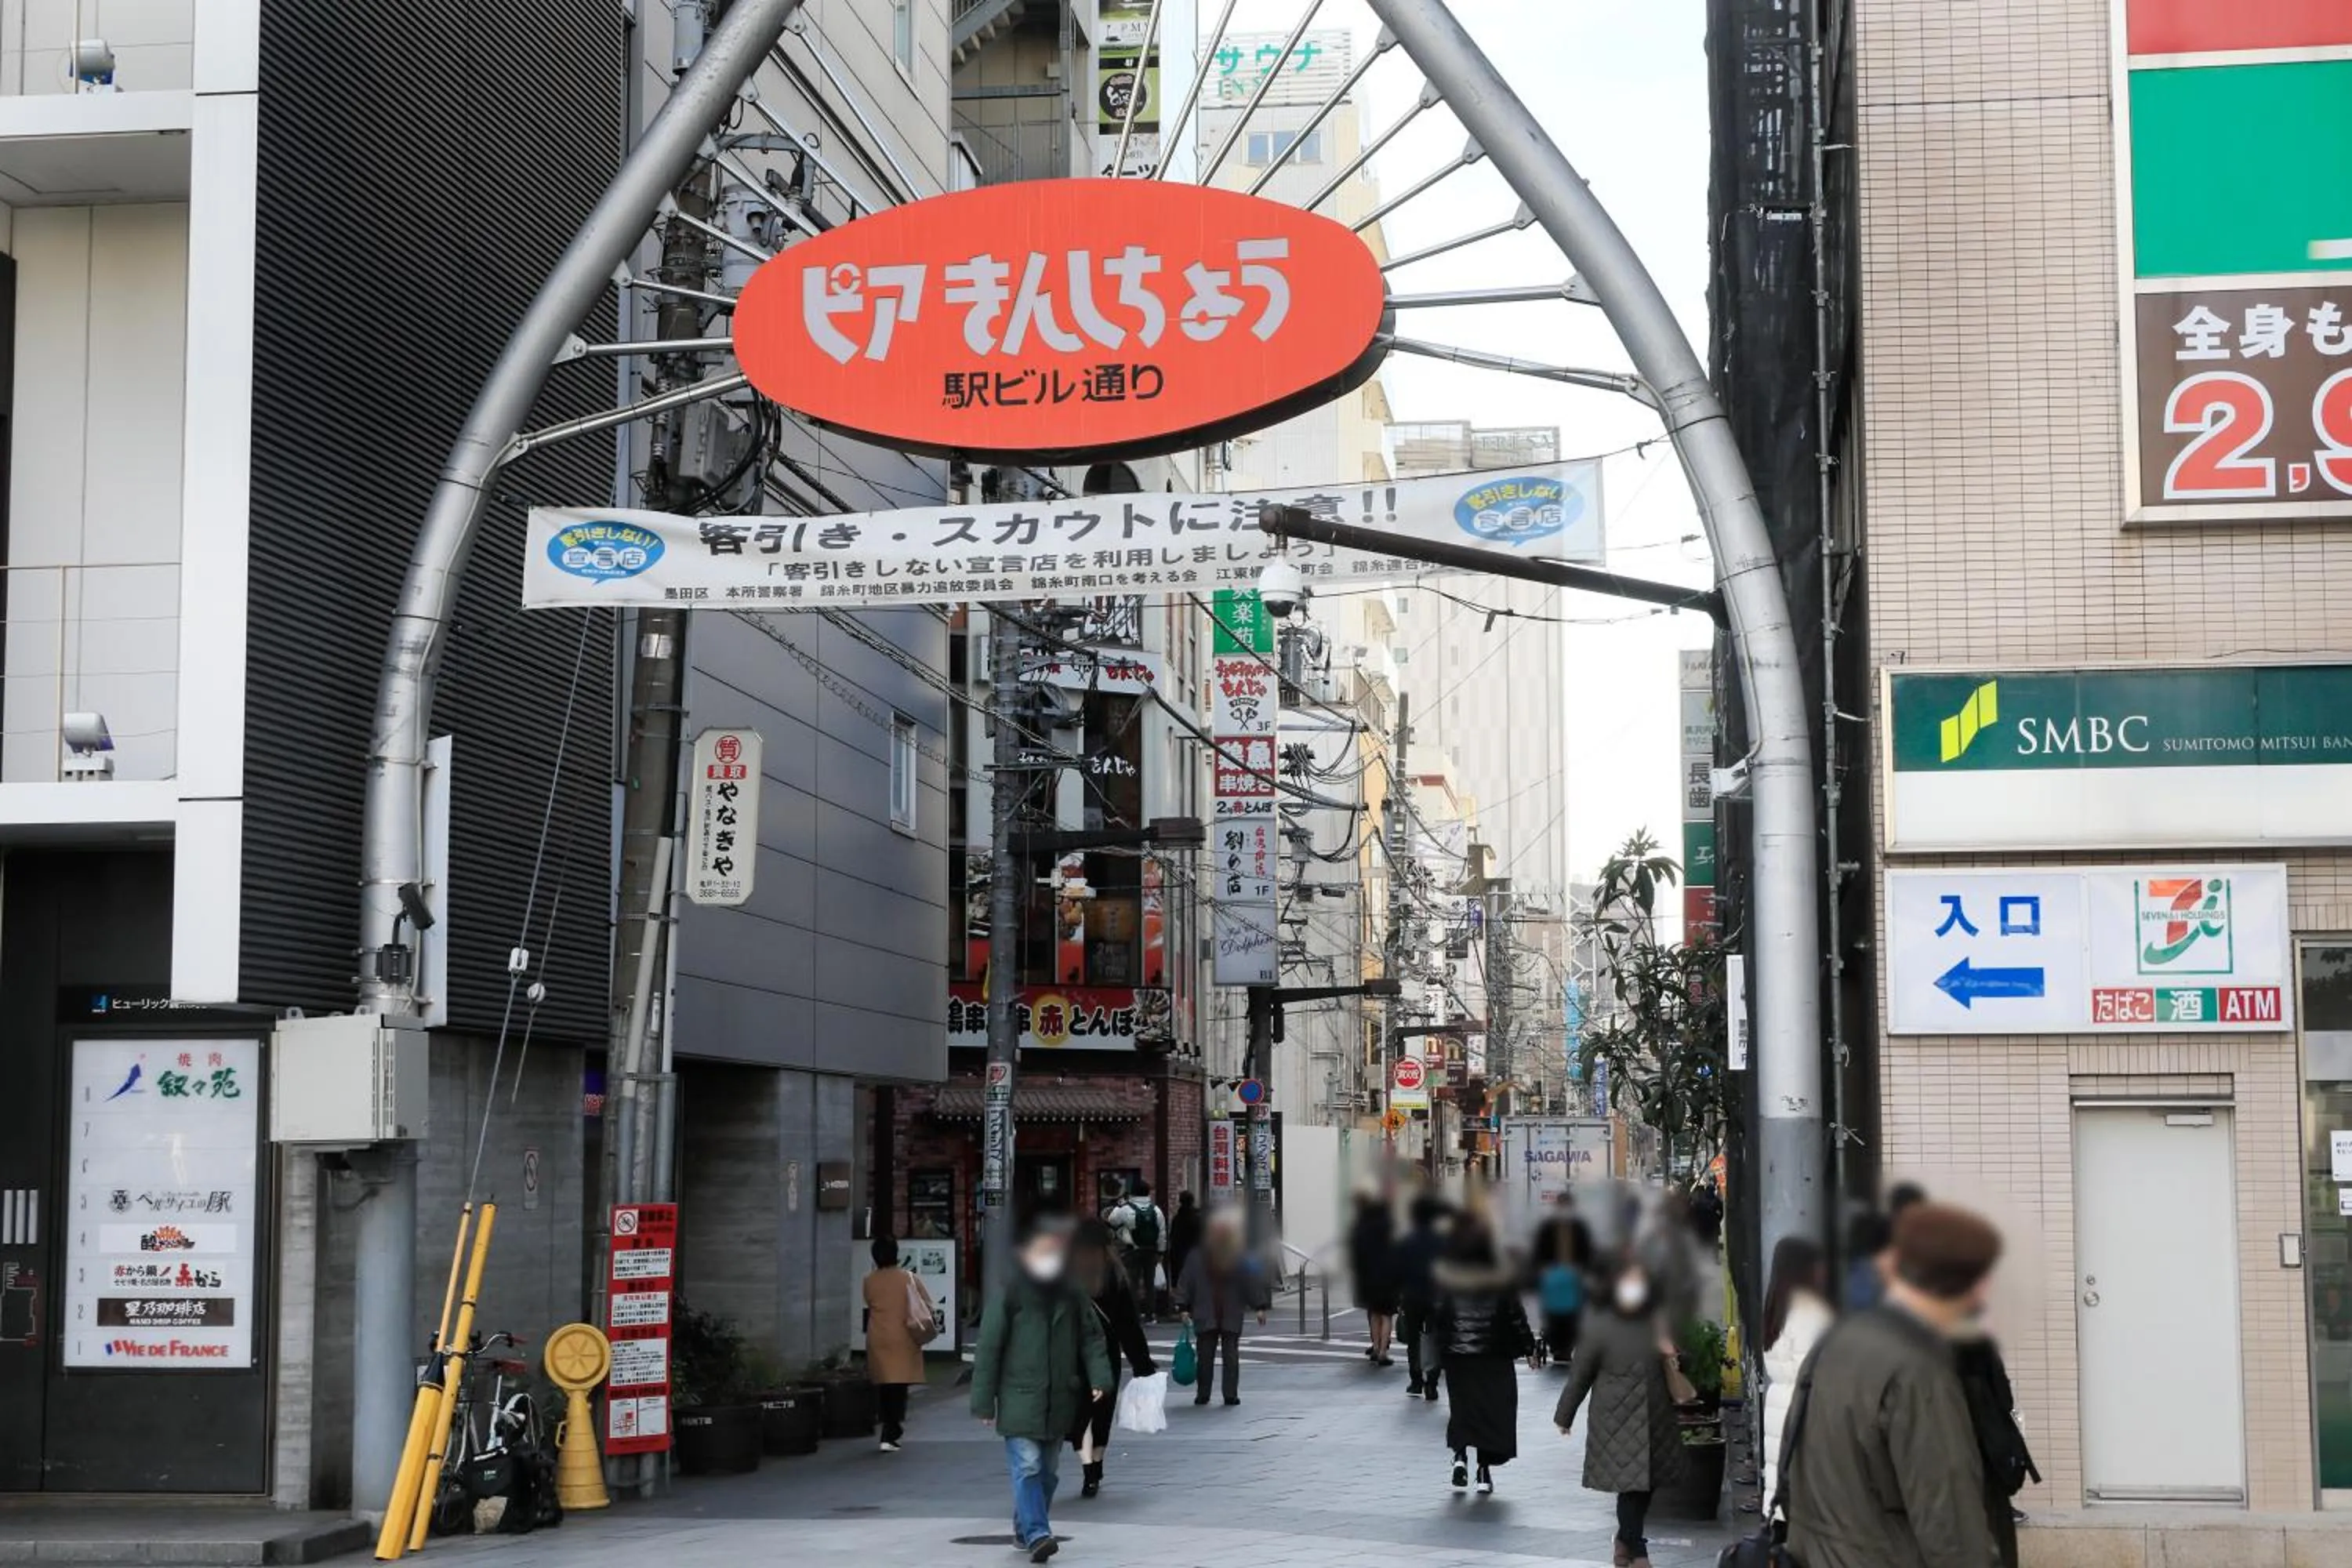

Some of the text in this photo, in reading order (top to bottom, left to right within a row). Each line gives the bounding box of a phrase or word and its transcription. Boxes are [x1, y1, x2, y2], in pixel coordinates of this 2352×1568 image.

[1215, 42, 1323, 75] サウナ
[802, 238, 1290, 365] ピアきんしちょう
[942, 364, 1164, 410] 駅ビル通り
[664, 588, 709, 600] 墨田区
[726, 586, 803, 598] 本所警察署
[1031, 570, 1198, 589] 錦糸町南口を考える会
[1257, 720, 1271, 731] 3F
[2017, 715, 2149, 755] SMBC
[2163, 738, 2254, 751] SUMITOMO
[2261, 736, 2316, 750] MITSUI
[712, 781, 739, 877] やなぎや
[1254, 885, 1269, 896] 1F
[1933, 895, 2041, 938] 入口
[2181, 910, 2225, 920] HOLDINGS
[1039, 1004, 1134, 1036] 赤とんぼ
[2095, 990, 2276, 1021] たばこ 酒 ATM
[177, 1053, 223, 1066] 焼肉
[158, 1068, 241, 1098] 叙々苑
[1524, 1149, 1592, 1163] SAGAWA
[114, 1263, 222, 1288] 赤から鍋 赤から
[125, 1301, 207, 1317] 星乃珈琲店
[123, 1340, 230, 1357] VIE DE FRANCE
